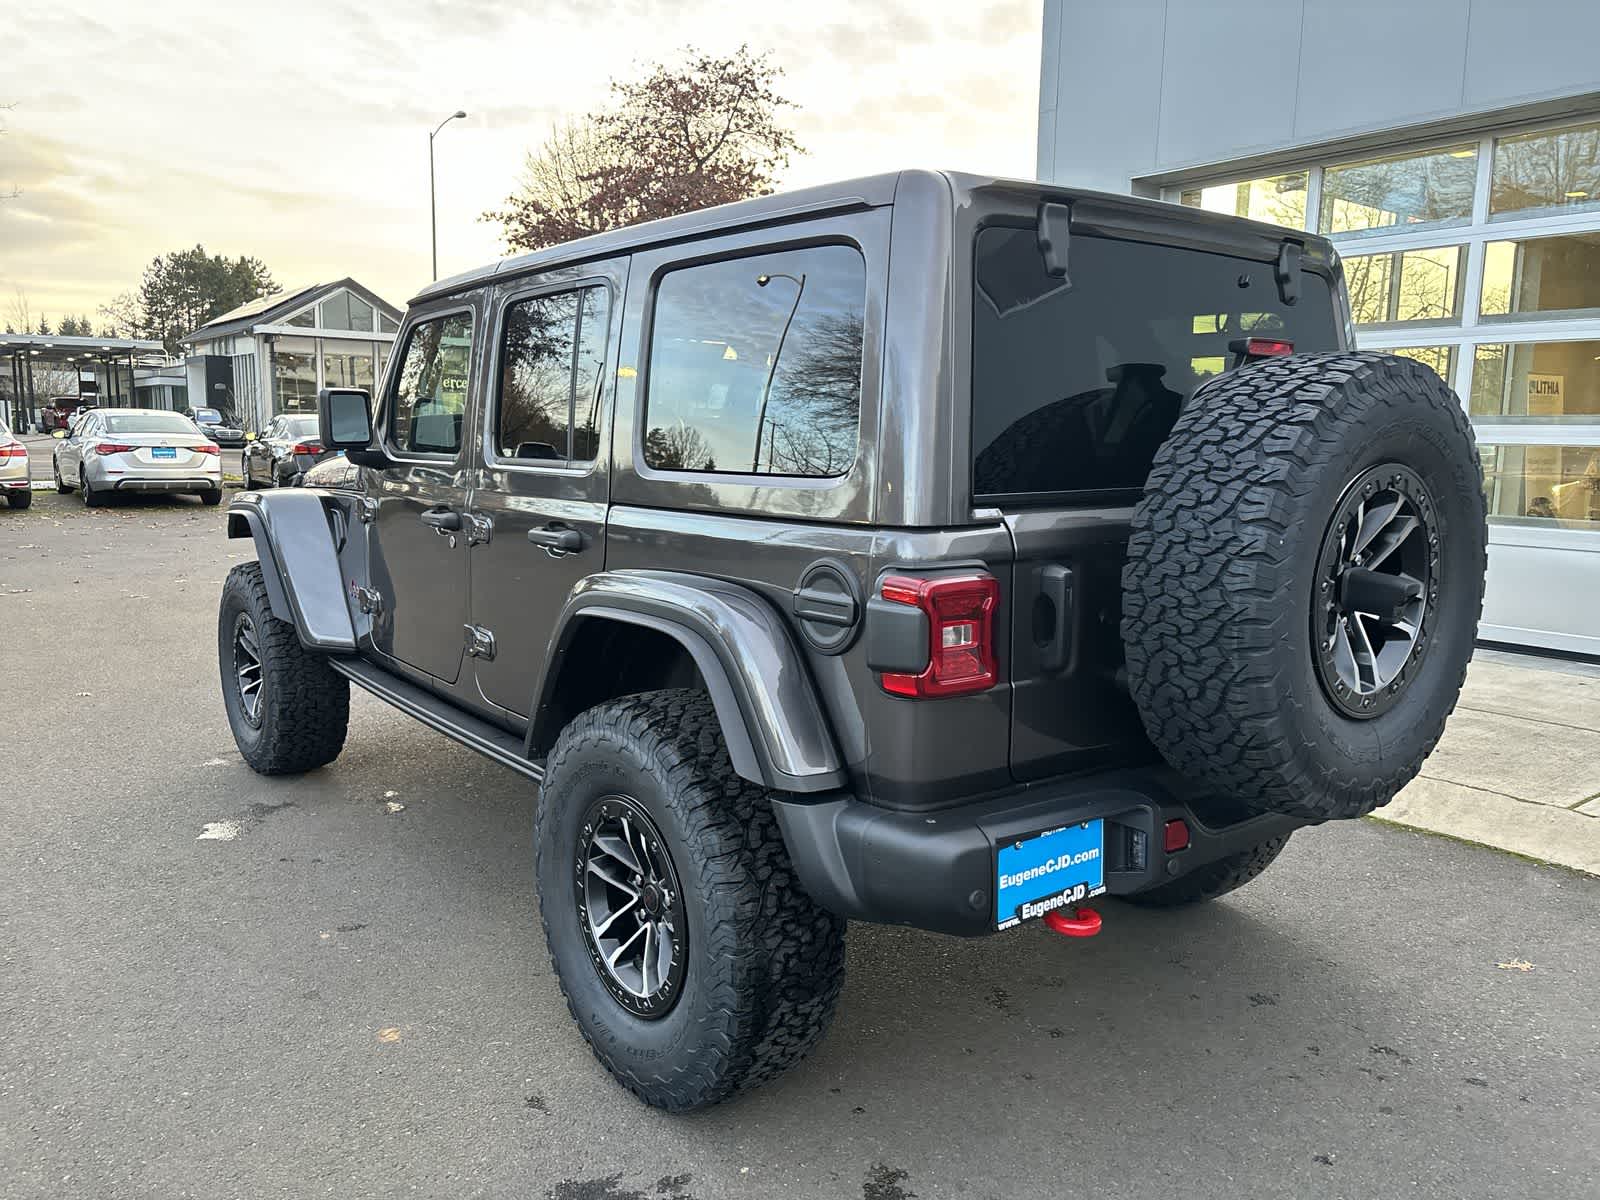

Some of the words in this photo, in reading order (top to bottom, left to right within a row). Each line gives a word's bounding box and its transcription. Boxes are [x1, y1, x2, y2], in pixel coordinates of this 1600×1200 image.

[1536, 380, 1559, 395] LITHIA
[999, 848, 1099, 890] EugeneCJD.com
[1022, 884, 1085, 919] EugeneCJD
